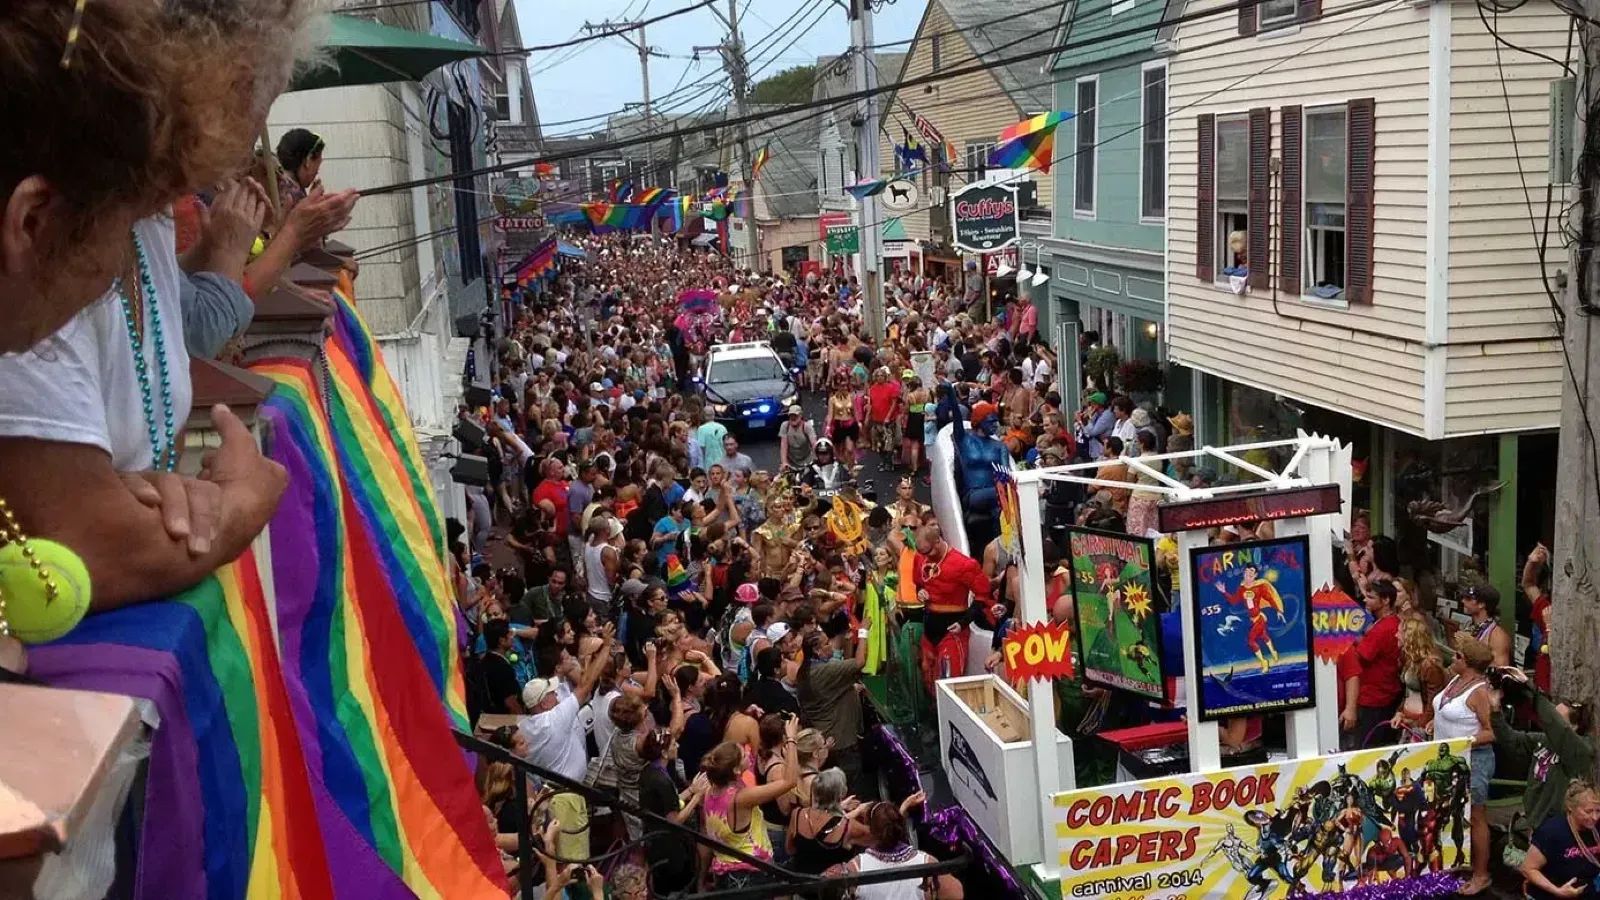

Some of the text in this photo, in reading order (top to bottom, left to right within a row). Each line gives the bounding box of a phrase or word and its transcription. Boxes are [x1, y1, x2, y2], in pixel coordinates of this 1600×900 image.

[499, 218, 542, 228] TATTOO
[956, 196, 1014, 219] Cuffy's
[987, 253, 1017, 270] ATM
[1072, 533, 1149, 570] CARNIVAL
[1005, 630, 1070, 670] POW
[1066, 772, 1280, 829] COMIC BOOK
[1069, 826, 1201, 870] CAPERS
[1072, 869, 1204, 897] carnival 2014
